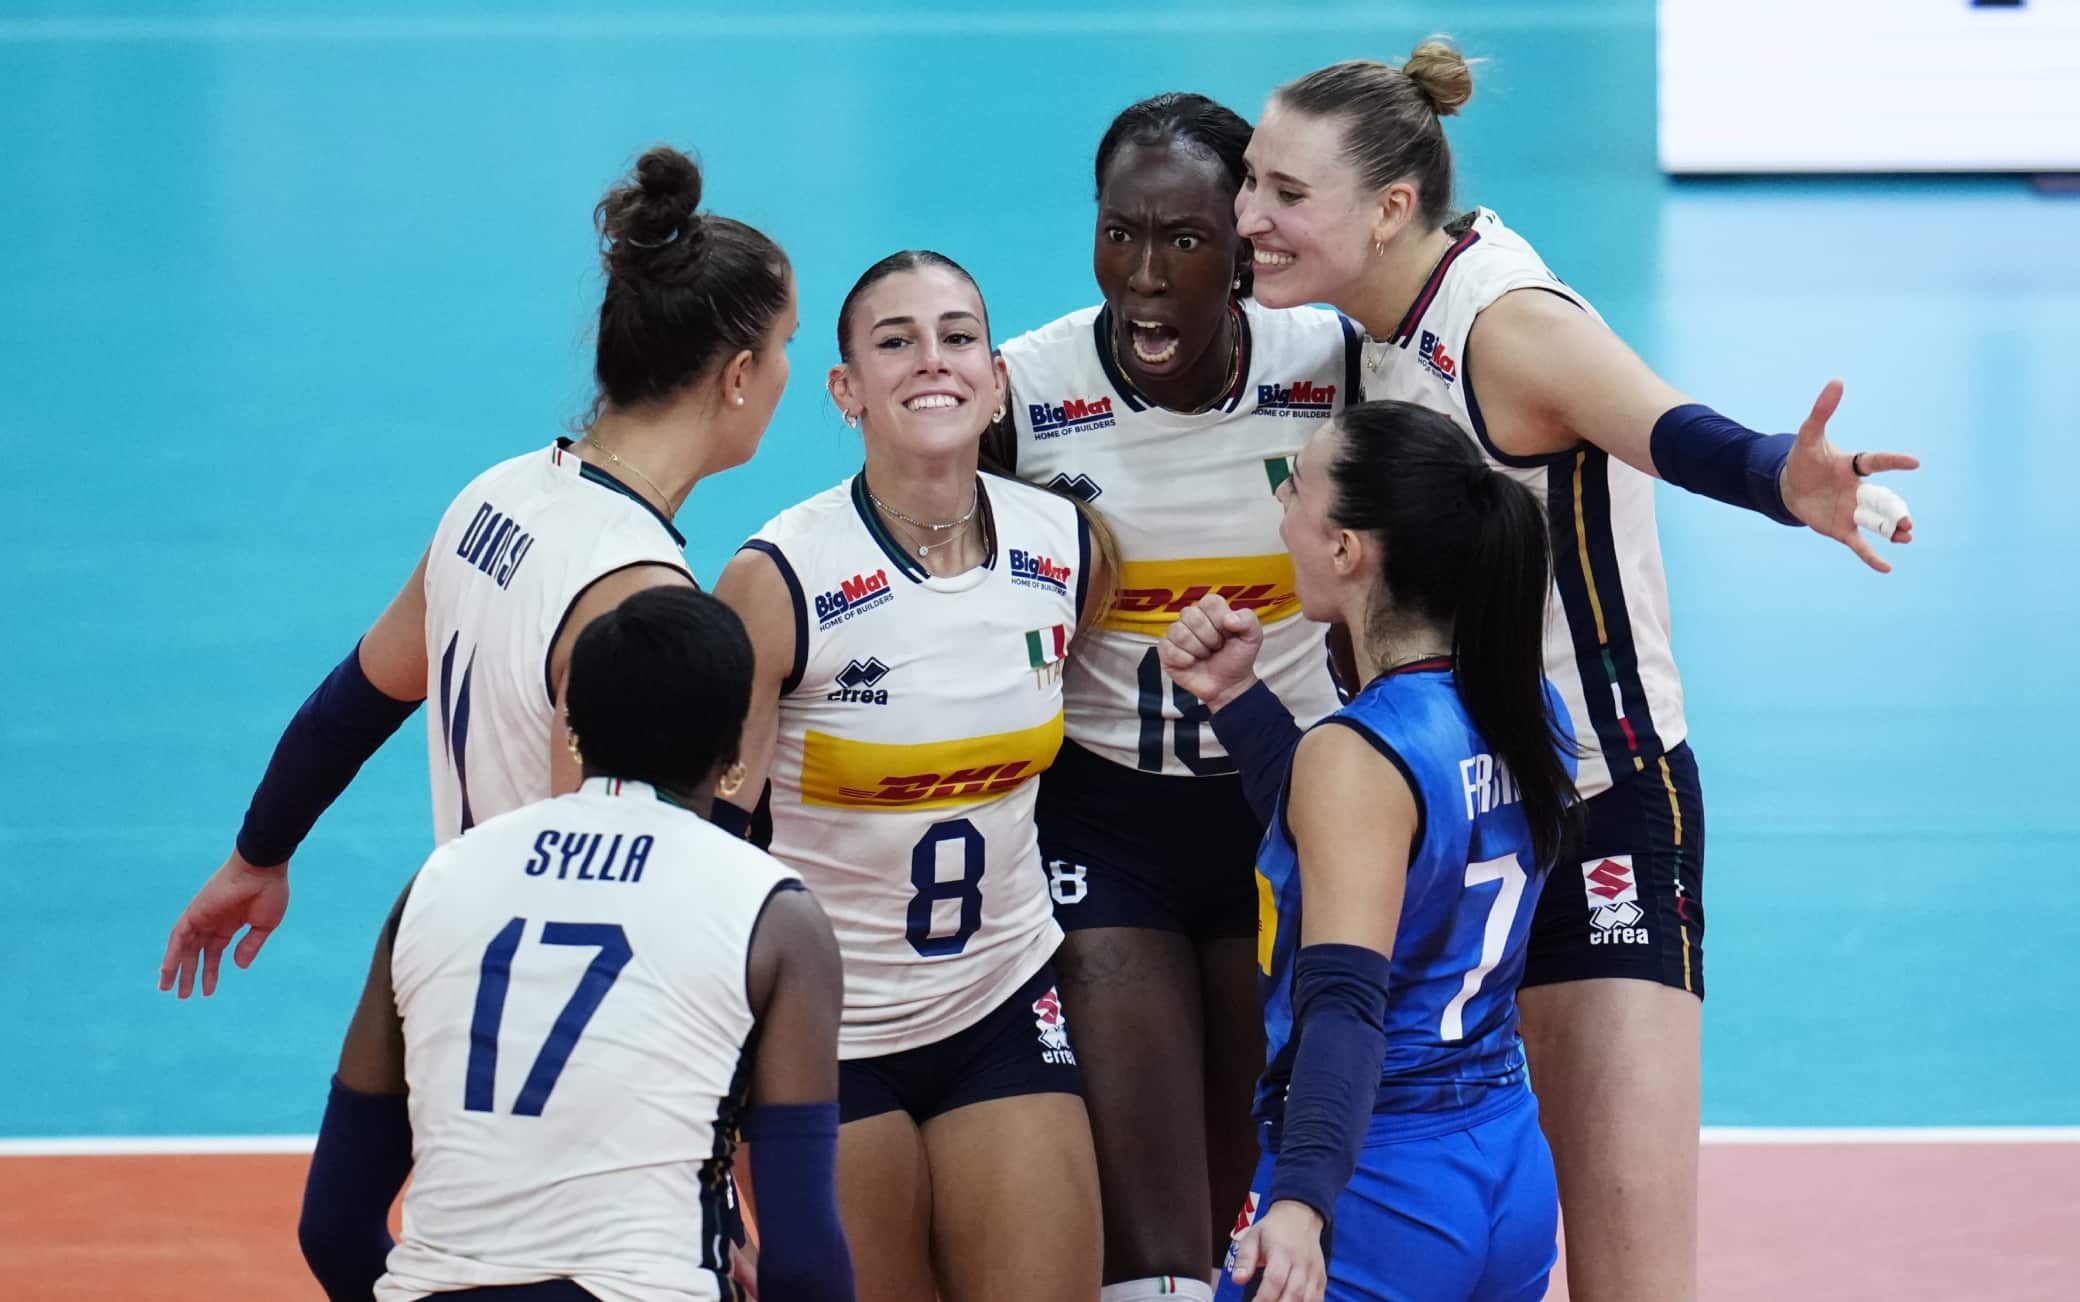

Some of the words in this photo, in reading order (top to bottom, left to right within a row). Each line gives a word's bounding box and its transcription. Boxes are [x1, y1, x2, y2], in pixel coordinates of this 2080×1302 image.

[1257, 381, 1336, 408] BigMat
[1029, 396, 1113, 427] BigMat
[1251, 408, 1277, 417] HOME
[1279, 409, 1290, 417] OF
[1293, 410, 1331, 419] BUILDERS
[1034, 430, 1060, 441] HOME
[1061, 428, 1073, 436] OF
[1075, 419, 1116, 433] BUILDERS
[1009, 549, 1071, 583] BigMat
[814, 568, 888, 617] BigMat
[1011, 578, 1031, 588] HOME
[1032, 581, 1040, 589] OF
[1114, 583, 1280, 613] DHL
[819, 616, 844, 632] HOME
[844, 609, 856, 621] OF
[856, 593, 895, 616] BUILDERS
[827, 688, 889, 705] errea
[870, 760, 1036, 801] DHL
[525, 830, 654, 883] SYLLA
[905, 818, 985, 957] 8
[1440, 852, 1527, 1041] 7
[1589, 927, 1649, 945] errea
[464, 916, 634, 1117] 17
